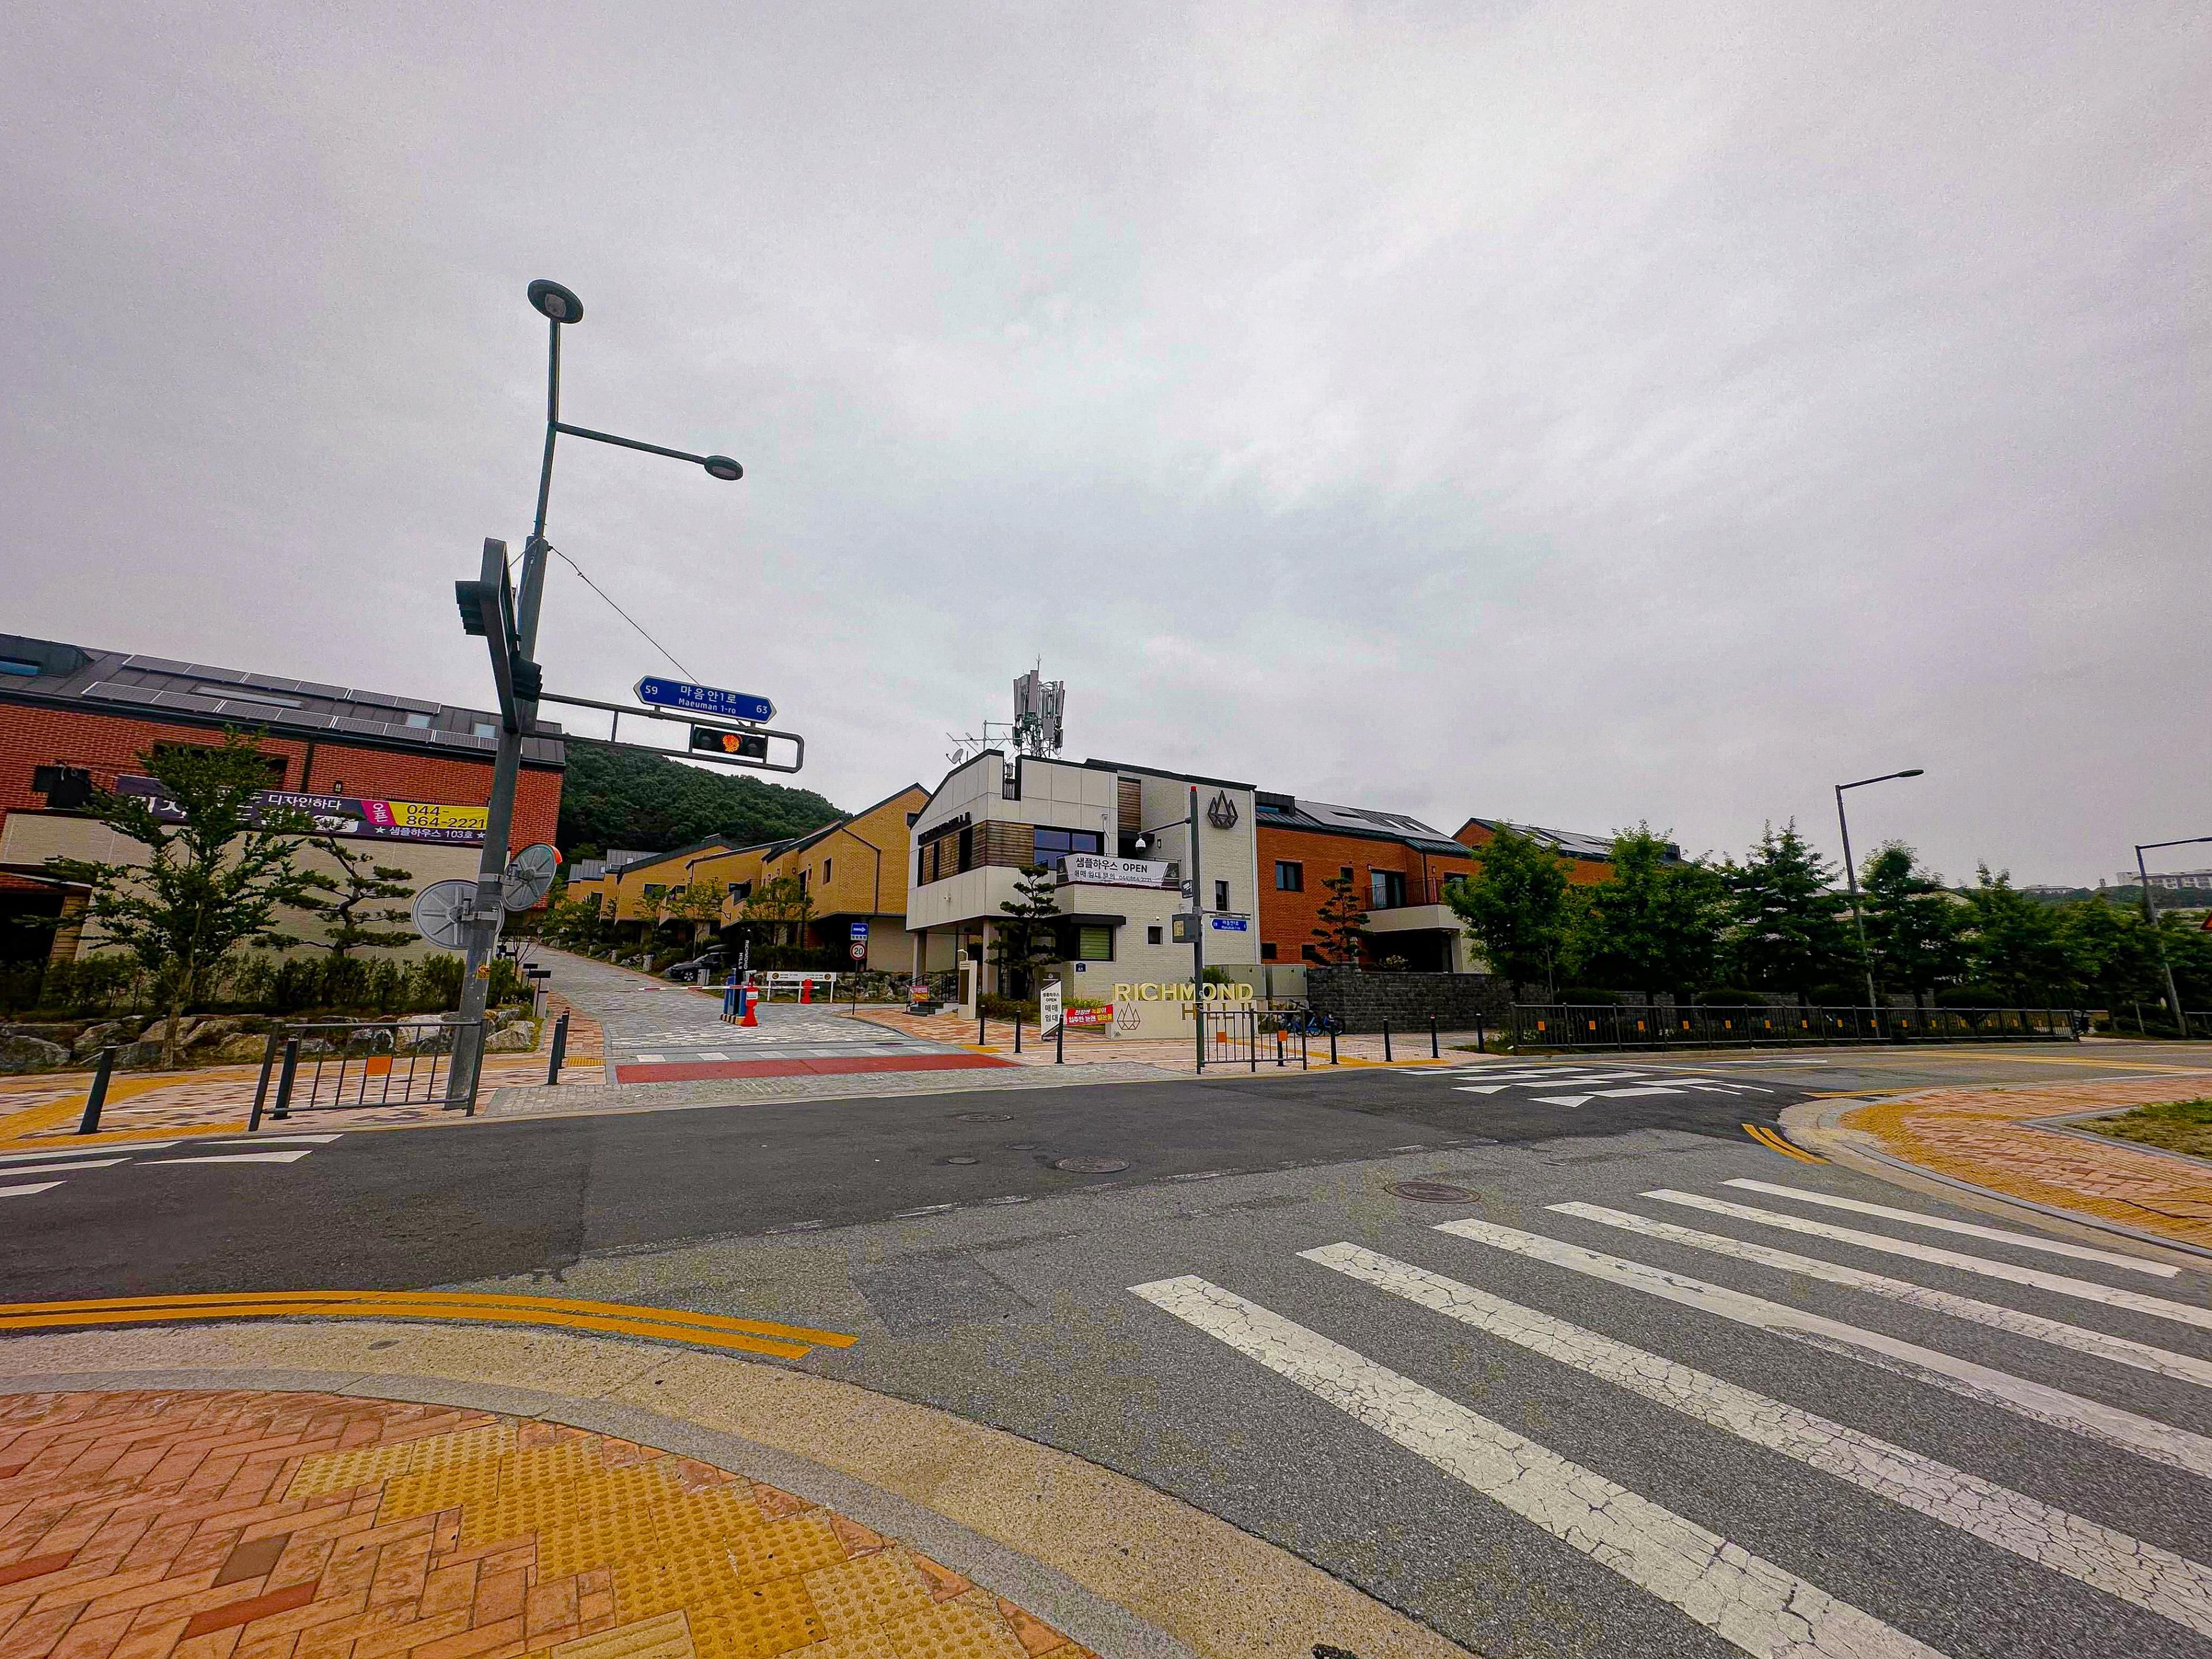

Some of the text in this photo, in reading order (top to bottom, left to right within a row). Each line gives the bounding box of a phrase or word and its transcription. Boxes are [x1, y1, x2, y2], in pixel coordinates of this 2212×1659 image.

[645, 685, 658, 695] 59
[680, 685, 737, 704] 마음안1로
[679, 698, 736, 714] Maeuman 1-ro
[756, 705, 767, 714] 63
[268, 794, 342, 810] 디자인하다
[407, 804, 449, 816] 044-
[373, 803, 388, 822] 오픈
[406, 815, 484, 828] 864-2221
[389, 827, 473, 839] 샘플하우스 103호
[1076, 857, 1147, 873] 샘플하우스 OPEN
[1113, 983, 1253, 1001] RICHMOND
[1181, 1003, 1234, 1020] HLL
